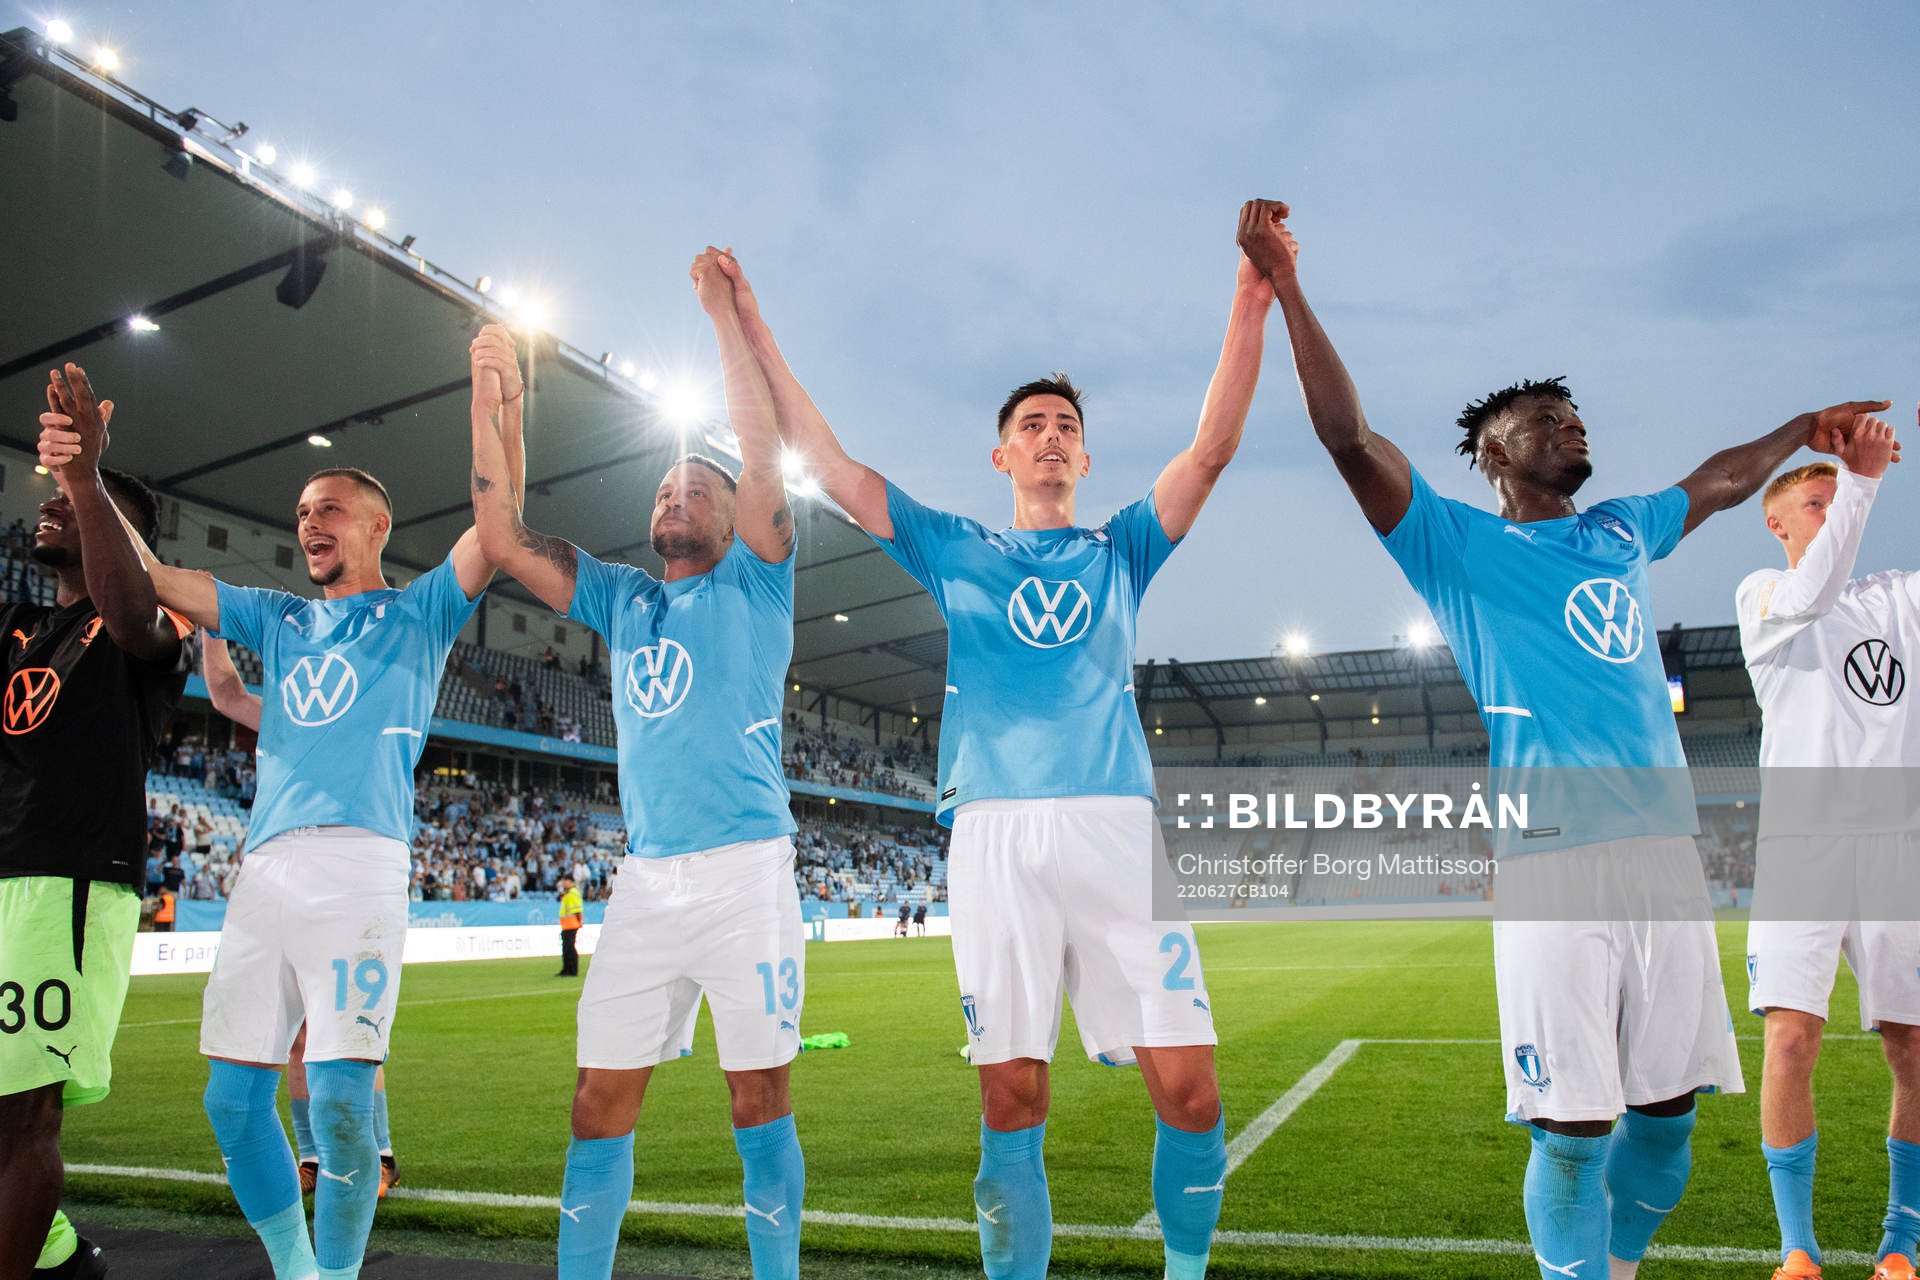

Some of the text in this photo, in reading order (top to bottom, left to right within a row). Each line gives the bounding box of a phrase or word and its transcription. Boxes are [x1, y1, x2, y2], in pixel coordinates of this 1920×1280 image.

[1008, 577, 1091, 648] VW
[1565, 578, 1645, 664] VW
[3, 667, 61, 735] VW
[282, 653, 358, 727] VW
[626, 637, 693, 719] VW
[1844, 639, 1905, 706] VW
[158, 943, 217, 965] Er par
[332, 958, 388, 1012] 19
[756, 956, 799, 1016] 13
[1159, 931, 1206, 991] 2
[0, 978, 72, 1035] 30
